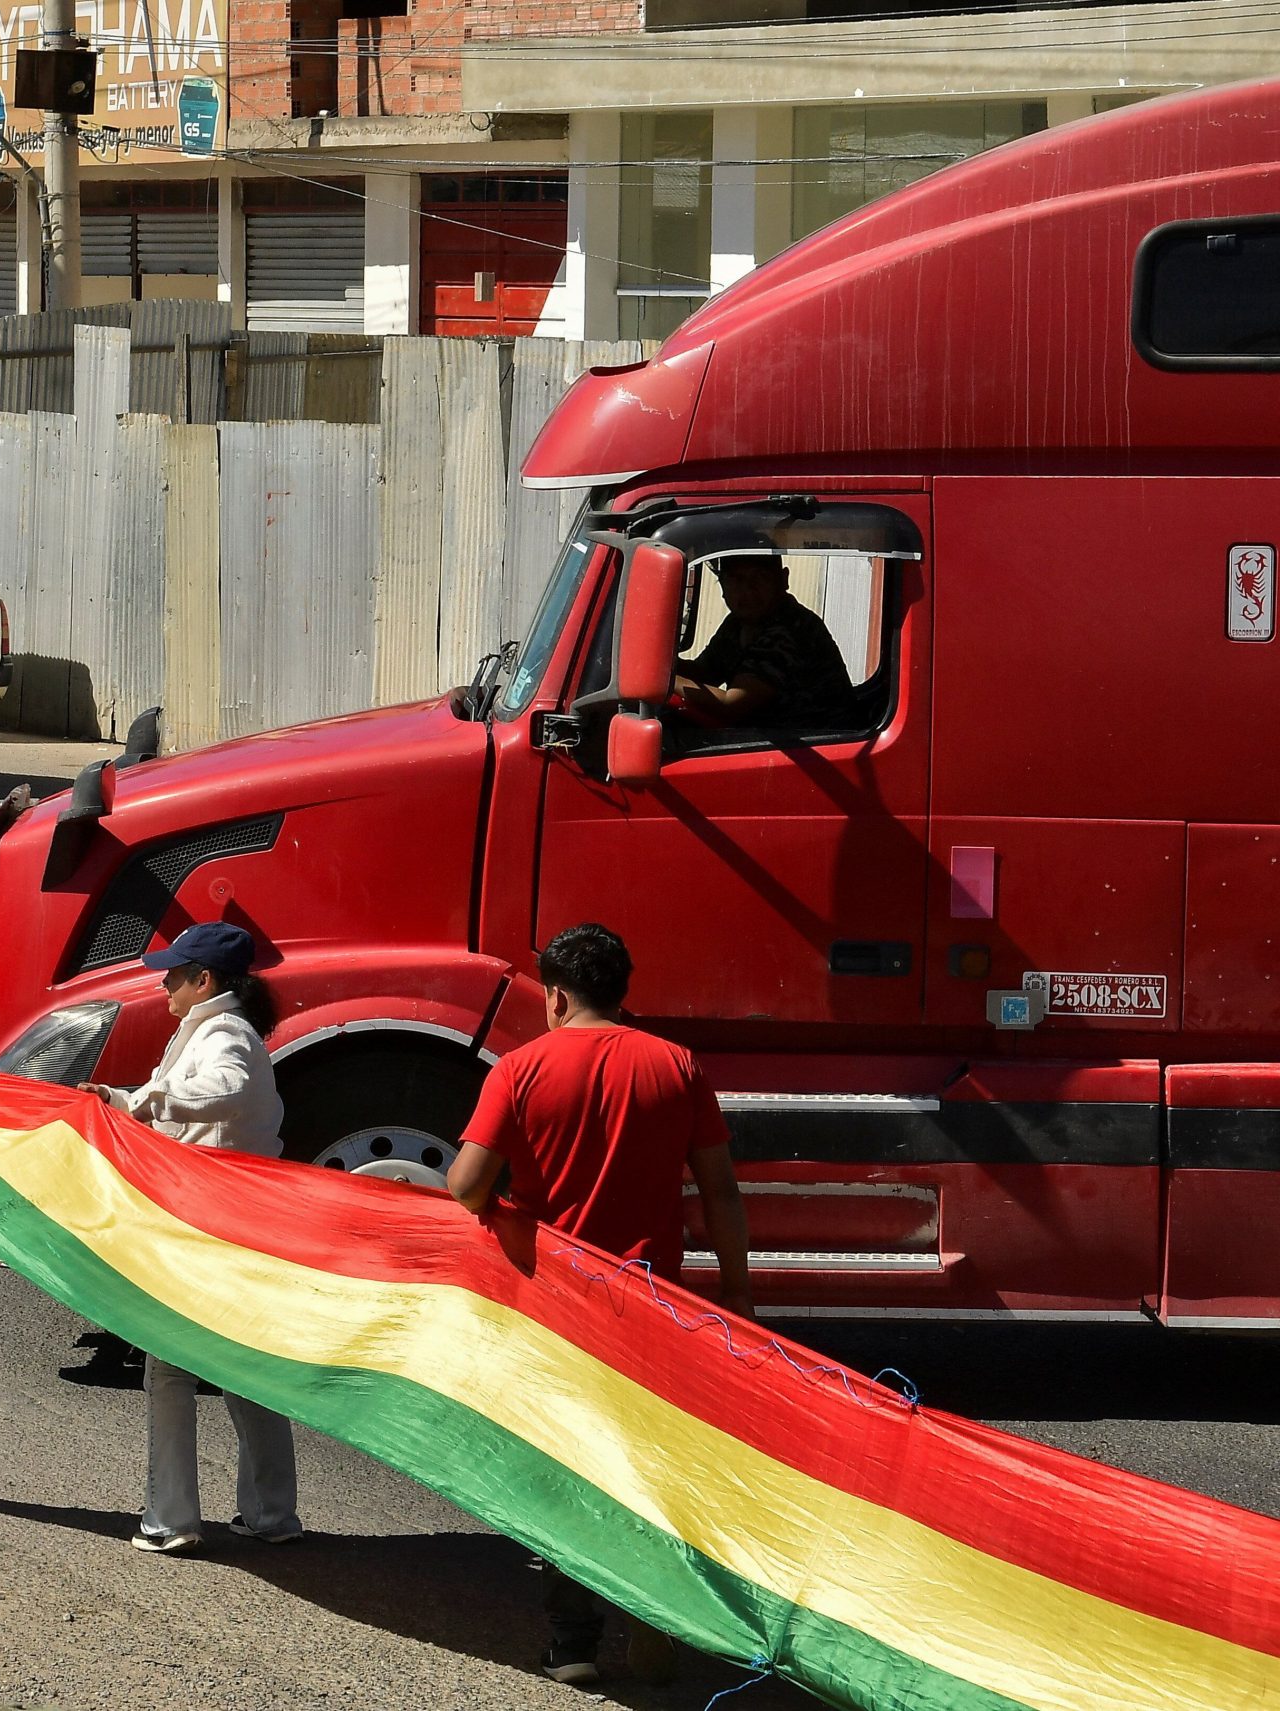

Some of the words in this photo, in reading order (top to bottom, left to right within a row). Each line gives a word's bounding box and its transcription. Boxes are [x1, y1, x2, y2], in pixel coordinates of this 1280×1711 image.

[107, 80, 178, 111] BATTERY
[124, 127, 133, 156] y
[136, 124, 176, 147] menor
[184, 122, 200, 137] GS
[1054, 975, 1075, 983] TRANS
[1114, 977, 1140, 985] ROMERO
[1142, 978, 1161, 986] S.R.L.
[1052, 983, 1162, 1009] 2508-SCX
